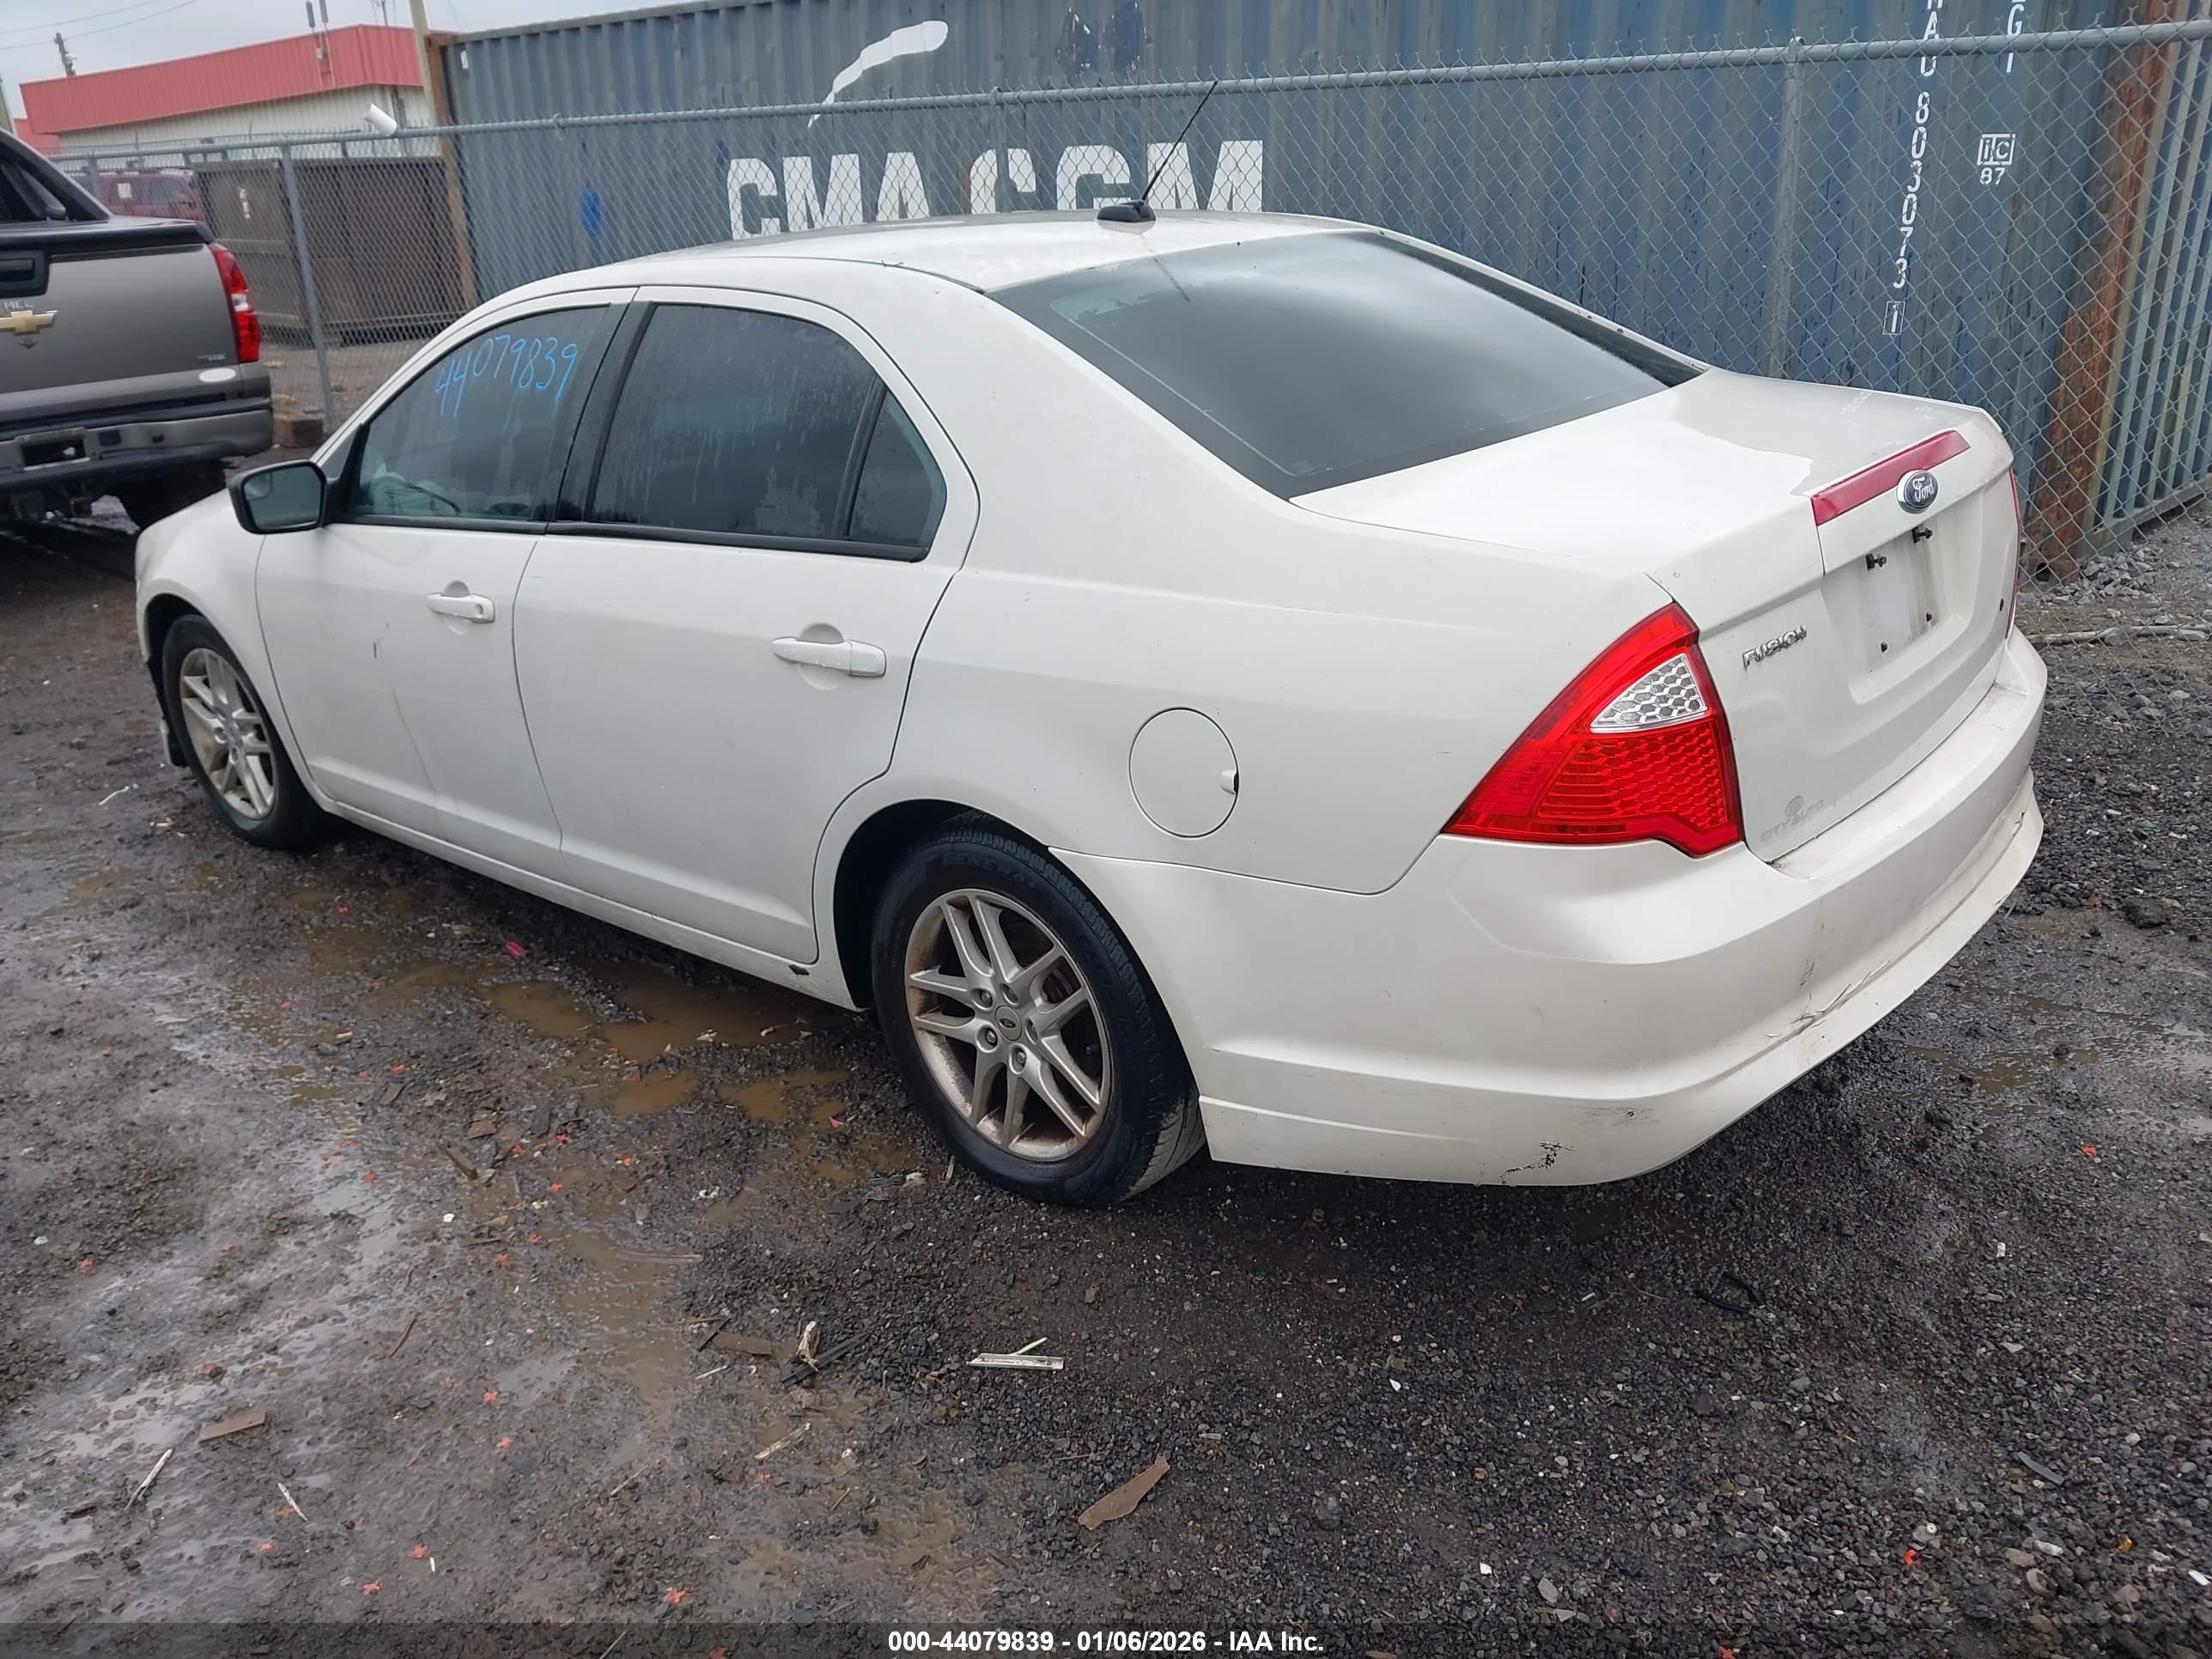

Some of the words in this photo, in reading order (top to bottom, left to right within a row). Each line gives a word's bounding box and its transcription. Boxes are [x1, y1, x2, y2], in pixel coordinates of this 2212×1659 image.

[1921, 0, 1943, 76] AU
[727, 151, 931, 240] CMA
[969, 139, 1264, 214] CGM
[1892, 91, 1930, 289] 803073
[1979, 167, 2006, 185] 87
[435, 334, 578, 416] 44079839
[1912, 476, 1935, 503] Ford
[1742, 624, 1807, 669] FUSION
